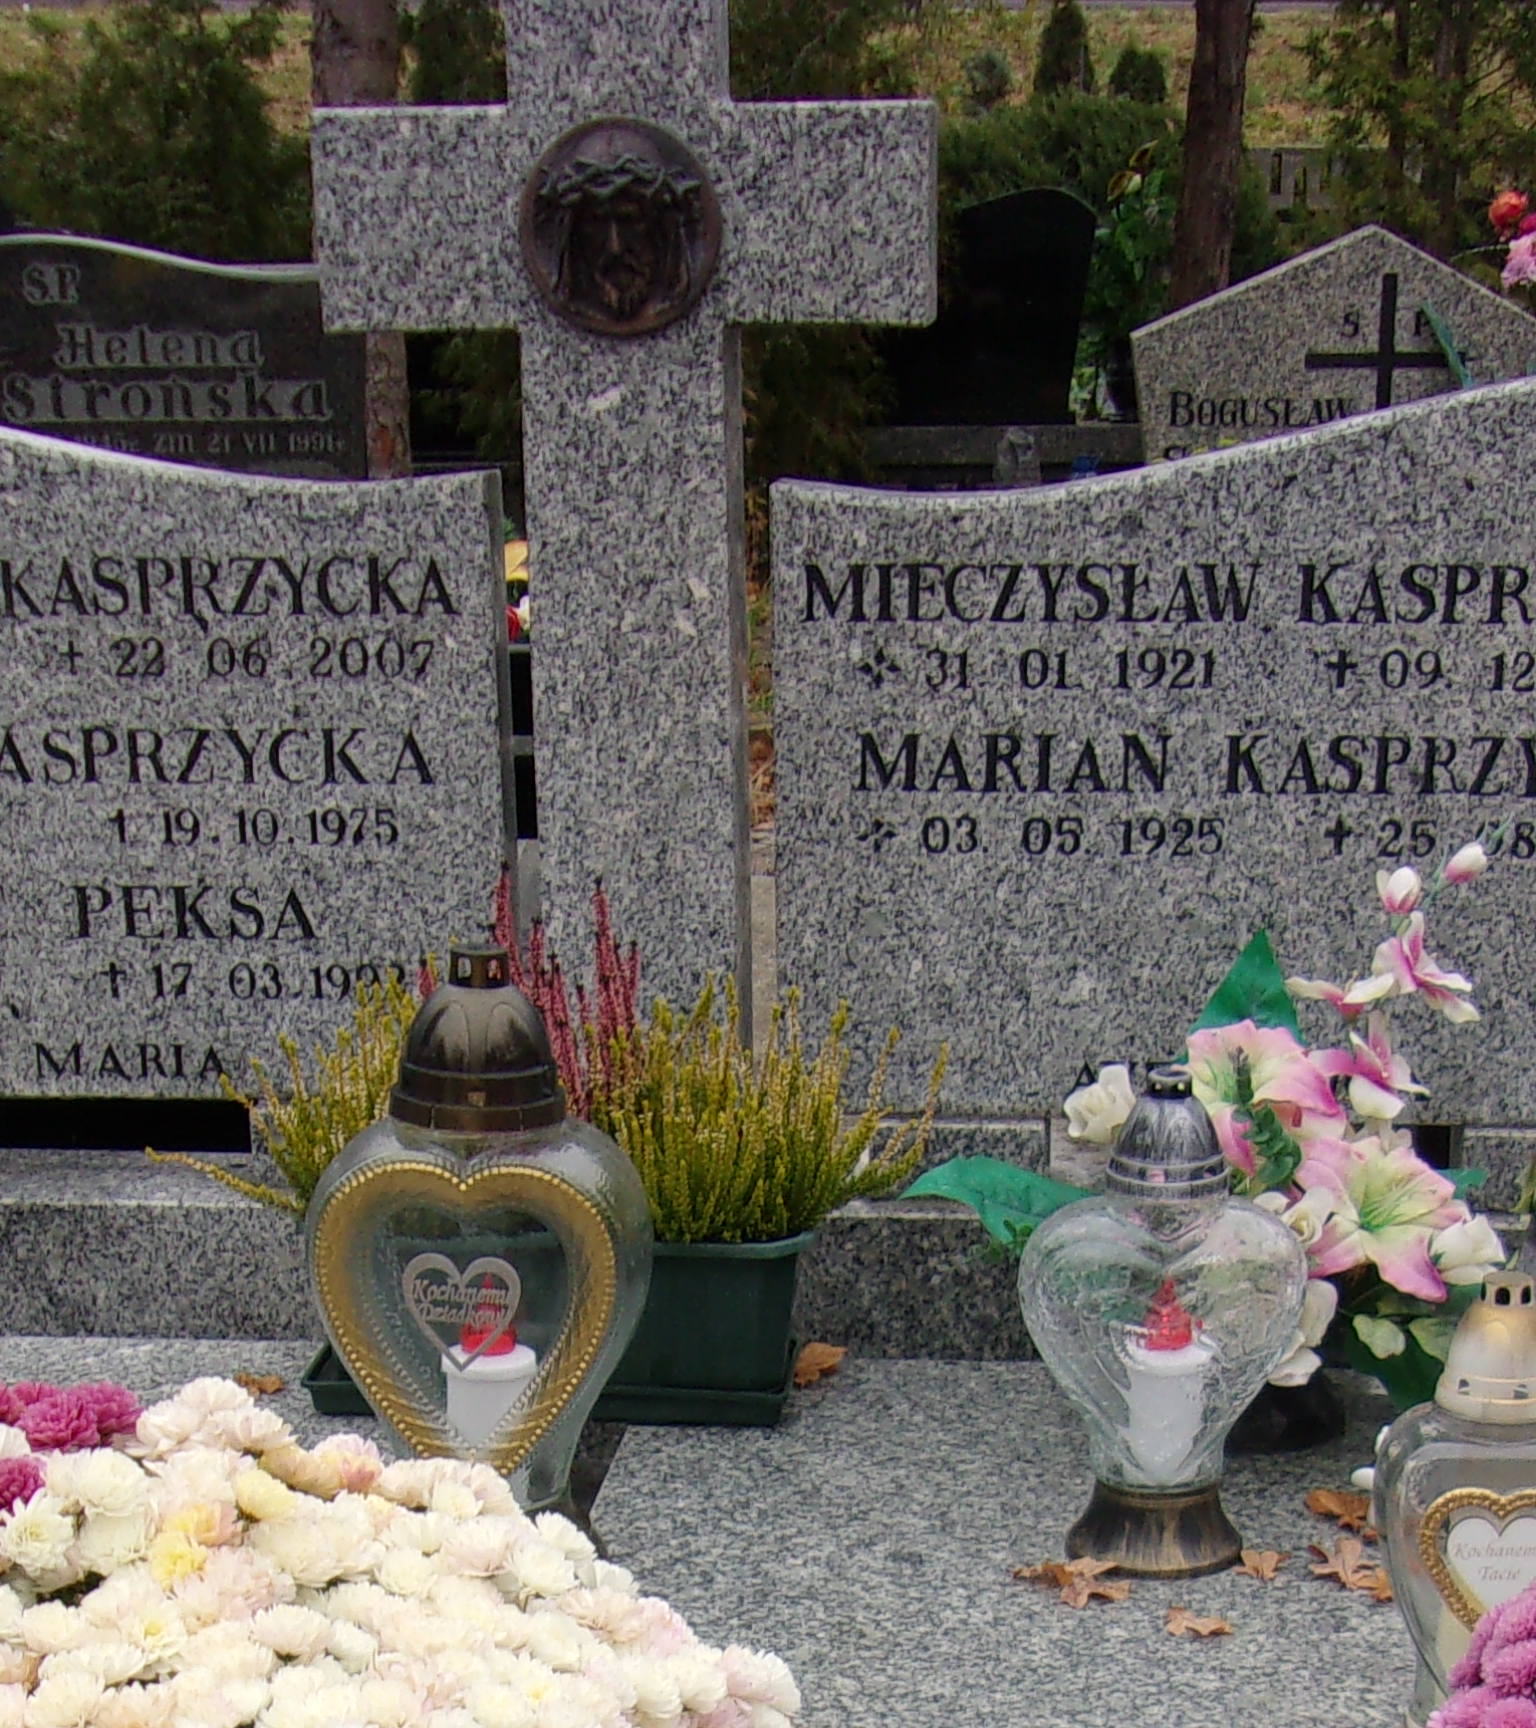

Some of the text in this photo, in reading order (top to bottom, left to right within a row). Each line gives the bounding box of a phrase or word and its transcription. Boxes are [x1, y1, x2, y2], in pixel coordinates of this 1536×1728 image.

[56, 323, 263, 368] Helena
[800, 562, 1264, 626] MIECZYSŁAW
[853, 732, 1171, 793] MARIAN
[69, 883, 320, 941] PEKSA
[34, 1040, 226, 1082] MARIA
